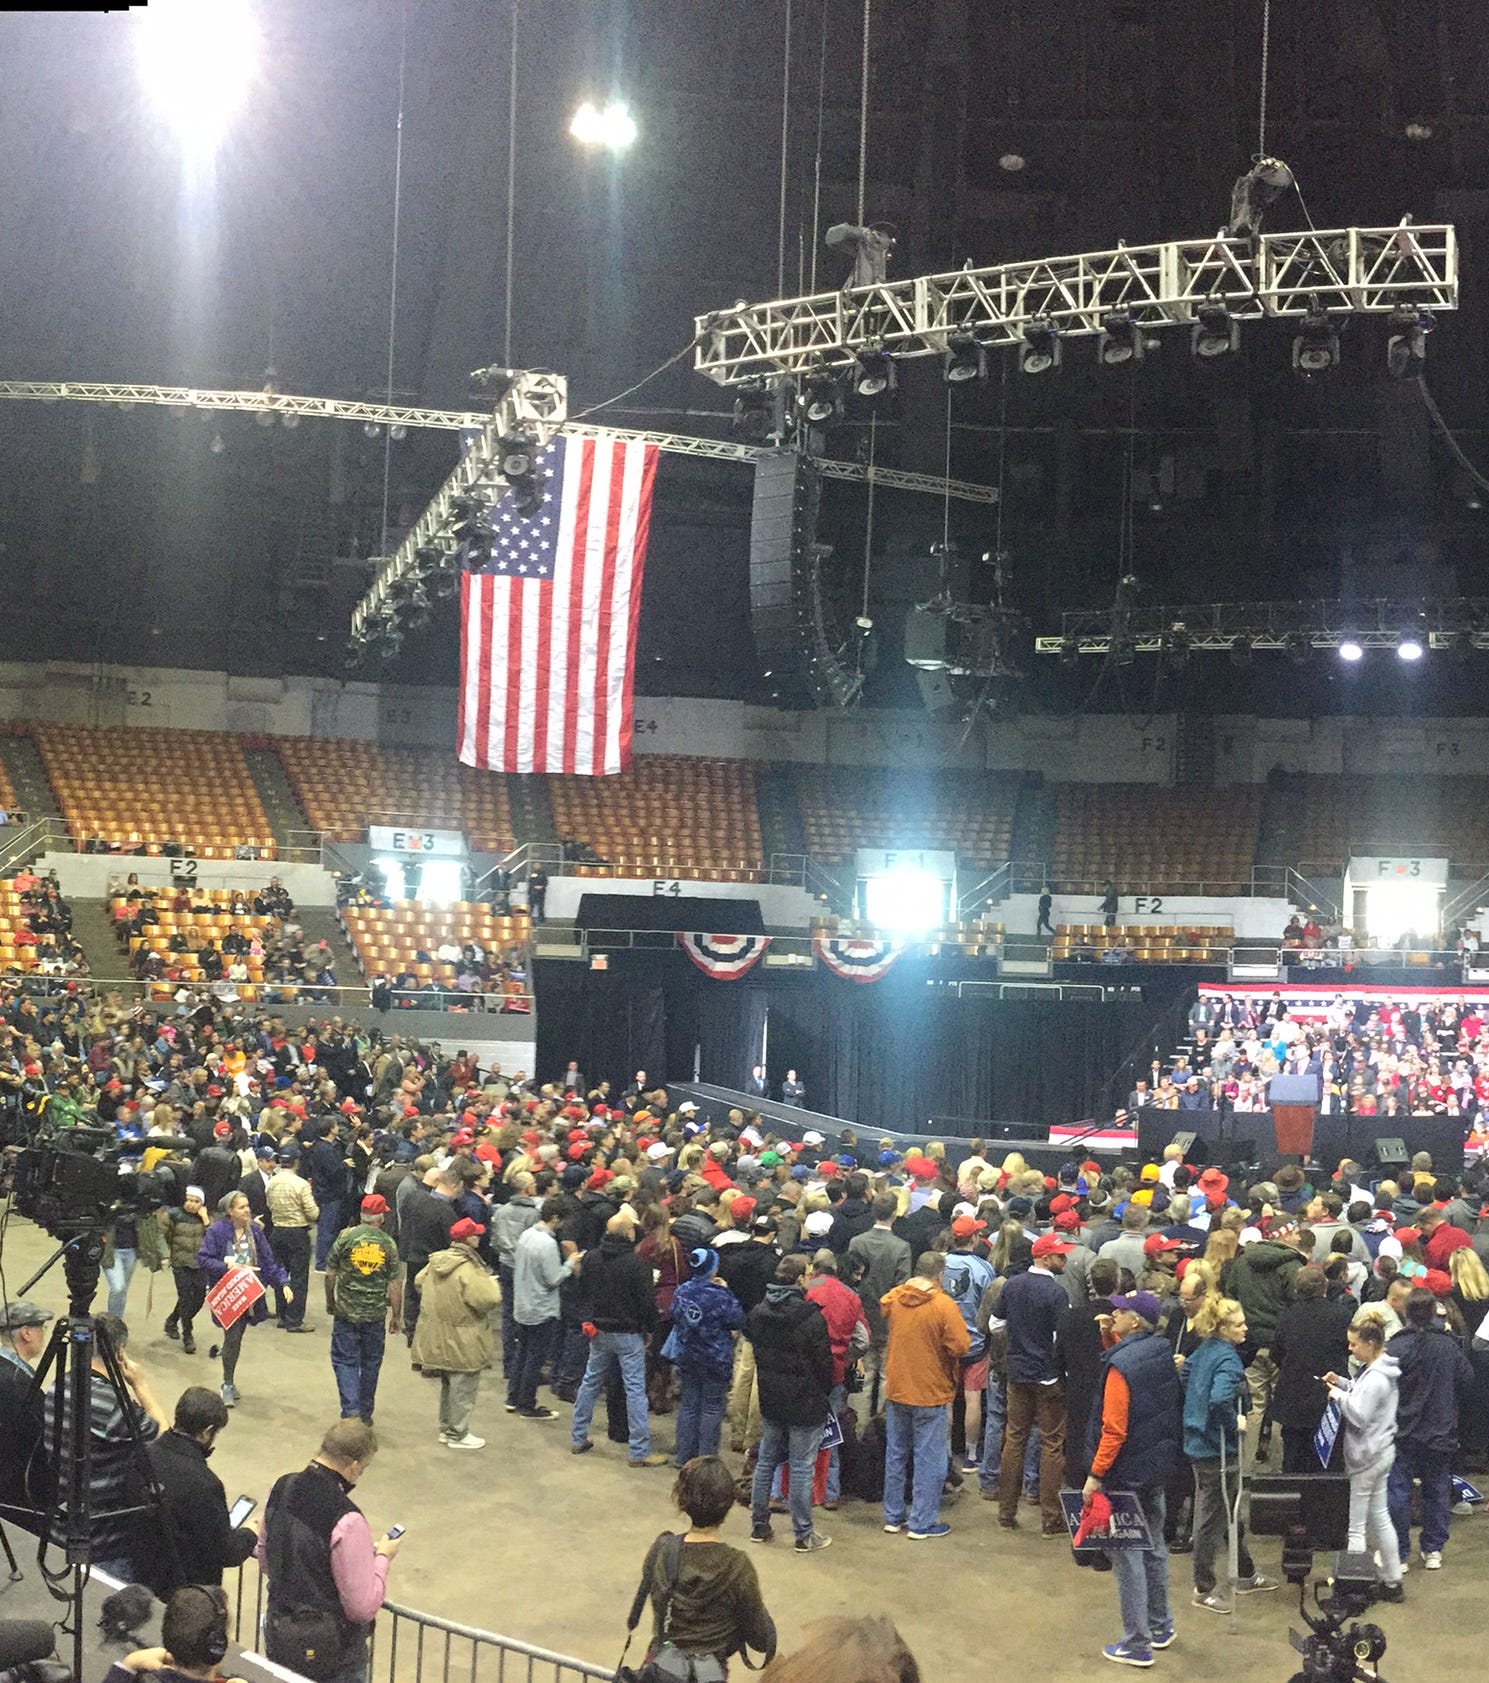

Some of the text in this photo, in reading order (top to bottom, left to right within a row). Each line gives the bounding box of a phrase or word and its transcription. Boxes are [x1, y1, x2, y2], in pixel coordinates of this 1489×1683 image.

[127, 691, 152, 706] E2
[634, 719, 658, 734] E4
[1142, 736, 1166, 751] F2
[1135, 897, 1162, 914] F2
[214, 1274, 254, 1316] AMERICA
[232, 1295, 248, 1312] MAKE
